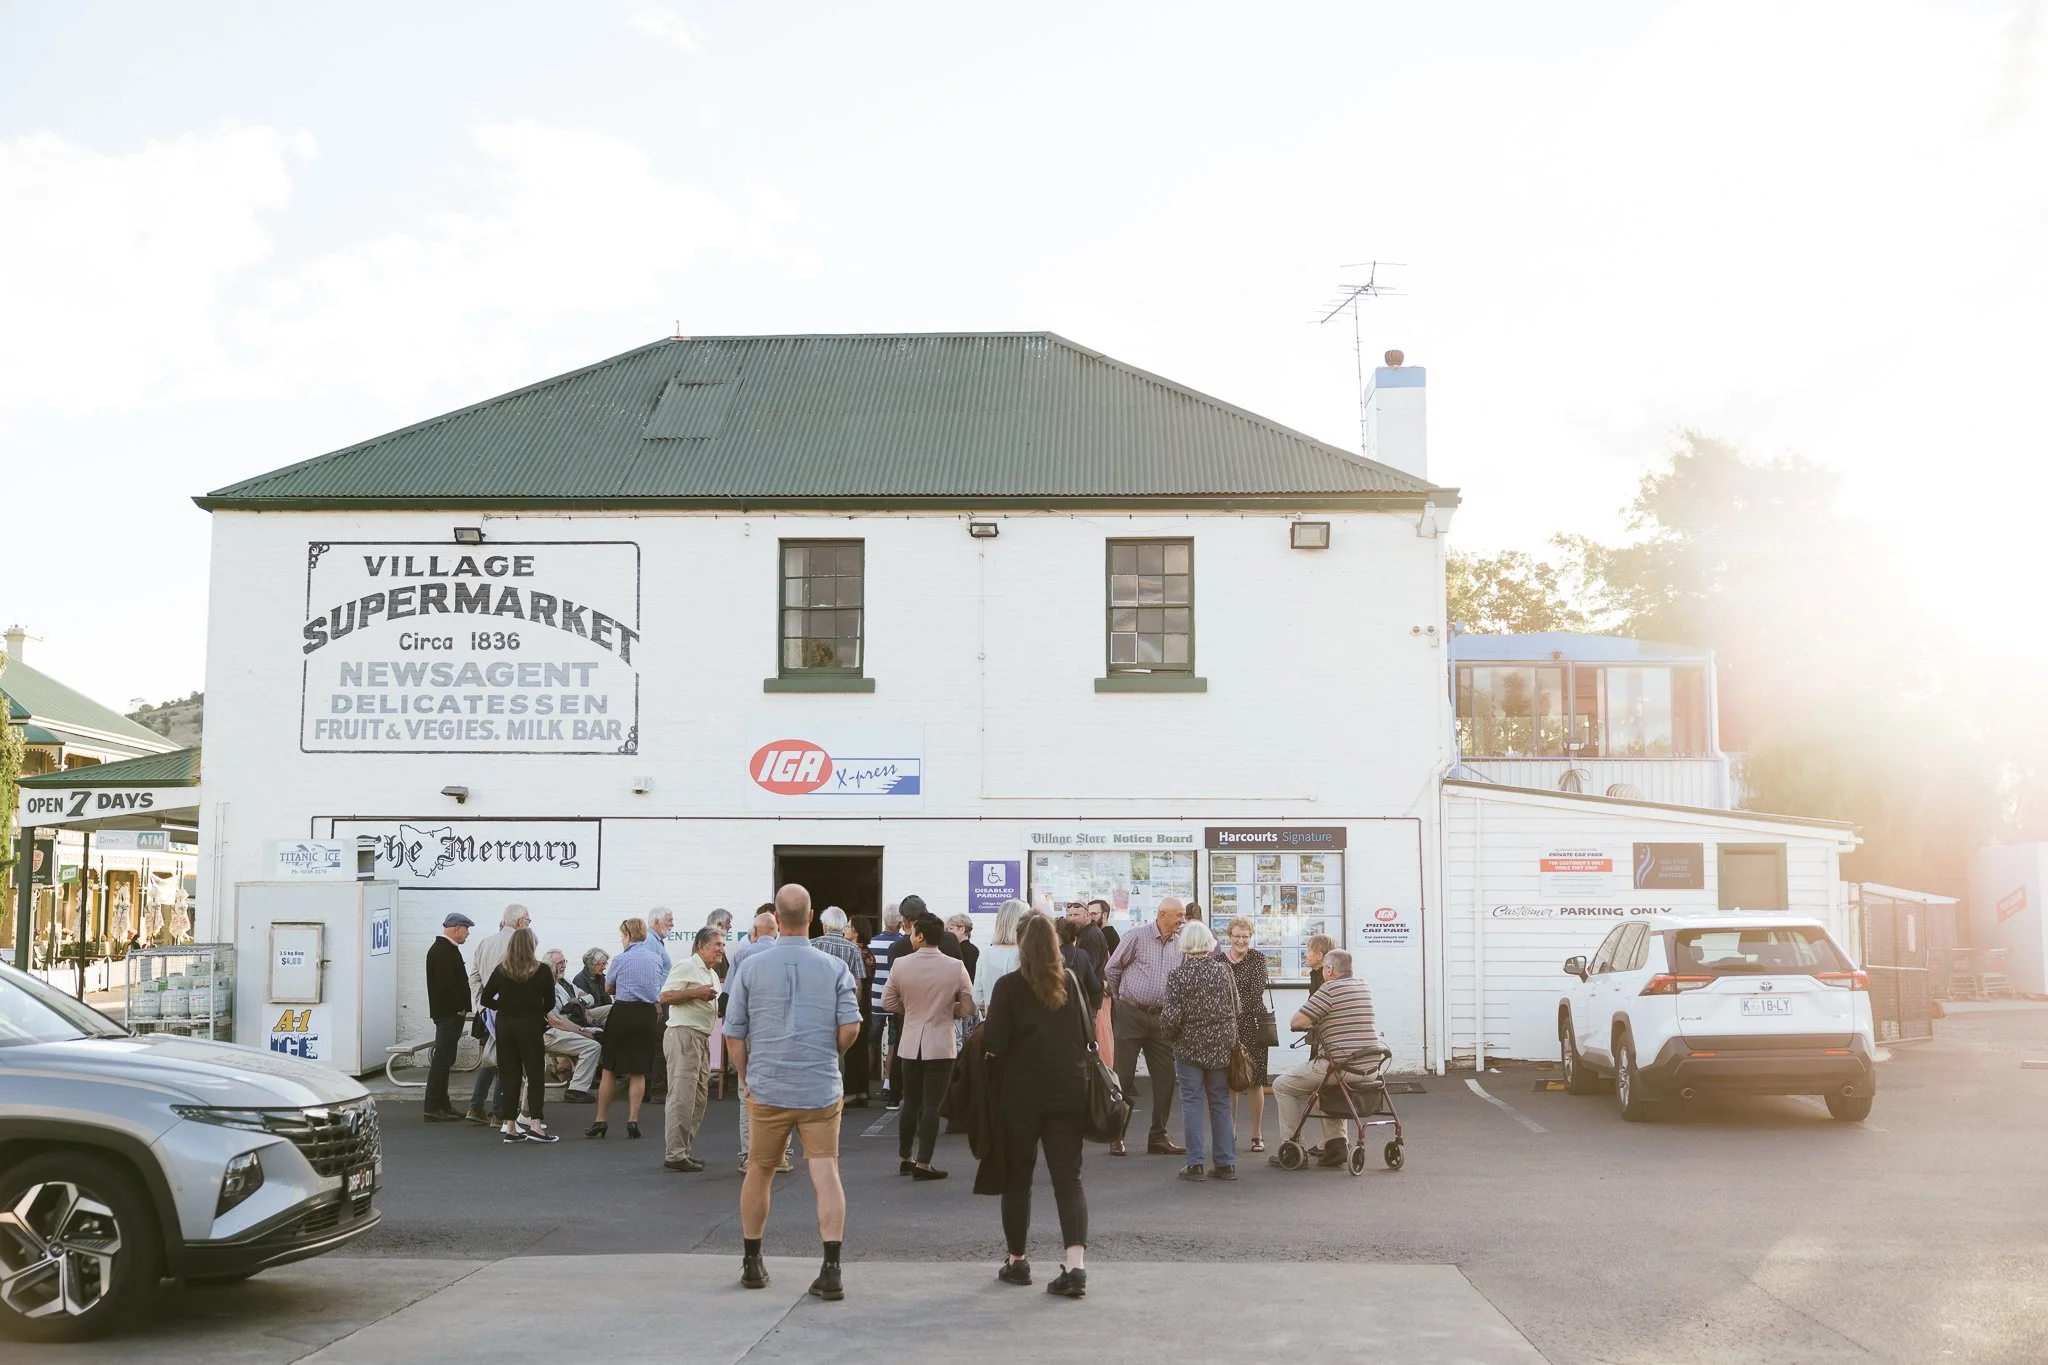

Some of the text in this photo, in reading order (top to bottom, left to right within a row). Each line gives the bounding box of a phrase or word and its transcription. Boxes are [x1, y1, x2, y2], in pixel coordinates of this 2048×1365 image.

[363, 555, 535, 577] VILLAGE
[303, 582, 640, 668] SUPERMARKET
[399, 632, 520, 650] Circa 1836
[340, 661, 599, 688] NEWSAGENT
[331, 694, 608, 714] DELICATESSEN
[314, 719, 384, 741] FRUIT
[404, 719, 500, 741] VEGIES.
[507, 719, 564, 741] MILK
[572, 719, 623, 741] BAR
[757, 750, 899, 790] IGA X-press
[27, 791, 154, 818] OPEN 7 DAYS
[140, 832, 163, 846] ATM
[1031, 833, 1193, 846] Village Store Notice Board
[1219, 831, 1332, 844] Harcourts Signature
[280, 852, 340, 862] TITANIC ICE
[437, 834, 580, 869] Mercury
[1377, 910, 1394, 918] IGA
[1493, 904, 1553, 918] Customer
[1560, 908, 1624, 916] PARKING
[372, 919, 389, 950] ICE
[668, 932, 732, 942] ENTRE
[273, 1009, 312, 1032] A-1
[270, 1032, 318, 1060] ICE
